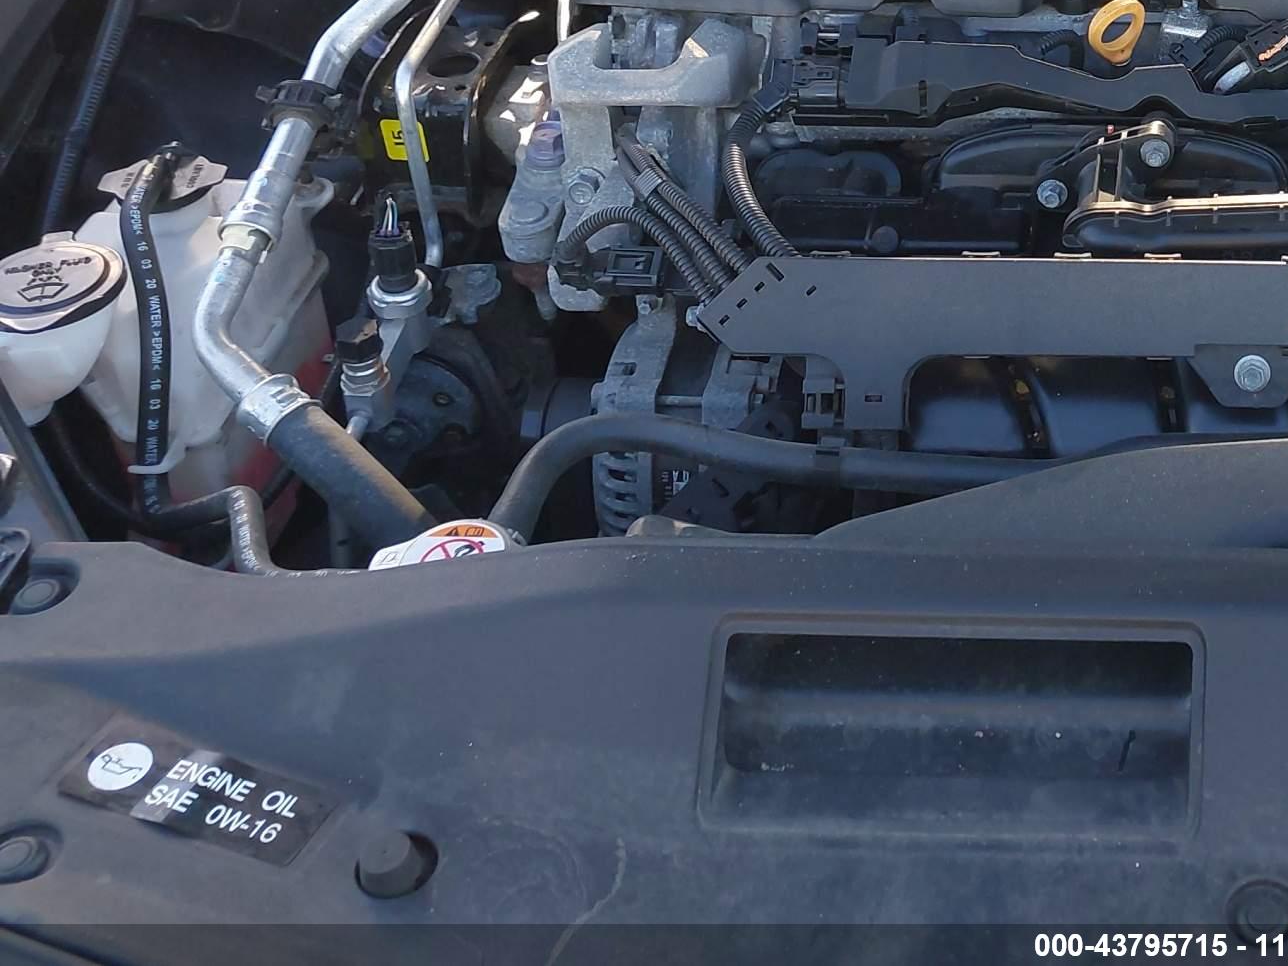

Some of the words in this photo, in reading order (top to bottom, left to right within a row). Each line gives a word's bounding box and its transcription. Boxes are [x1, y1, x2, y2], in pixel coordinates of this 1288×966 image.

[145, 278, 157, 289] 20
[148, 295, 162, 328] WATER
[166, 758, 257, 802] ENGINE
[261, 790, 299, 818] OIL
[144, 785, 200, 813] SAE
[204, 804, 282, 844] 0W-16
